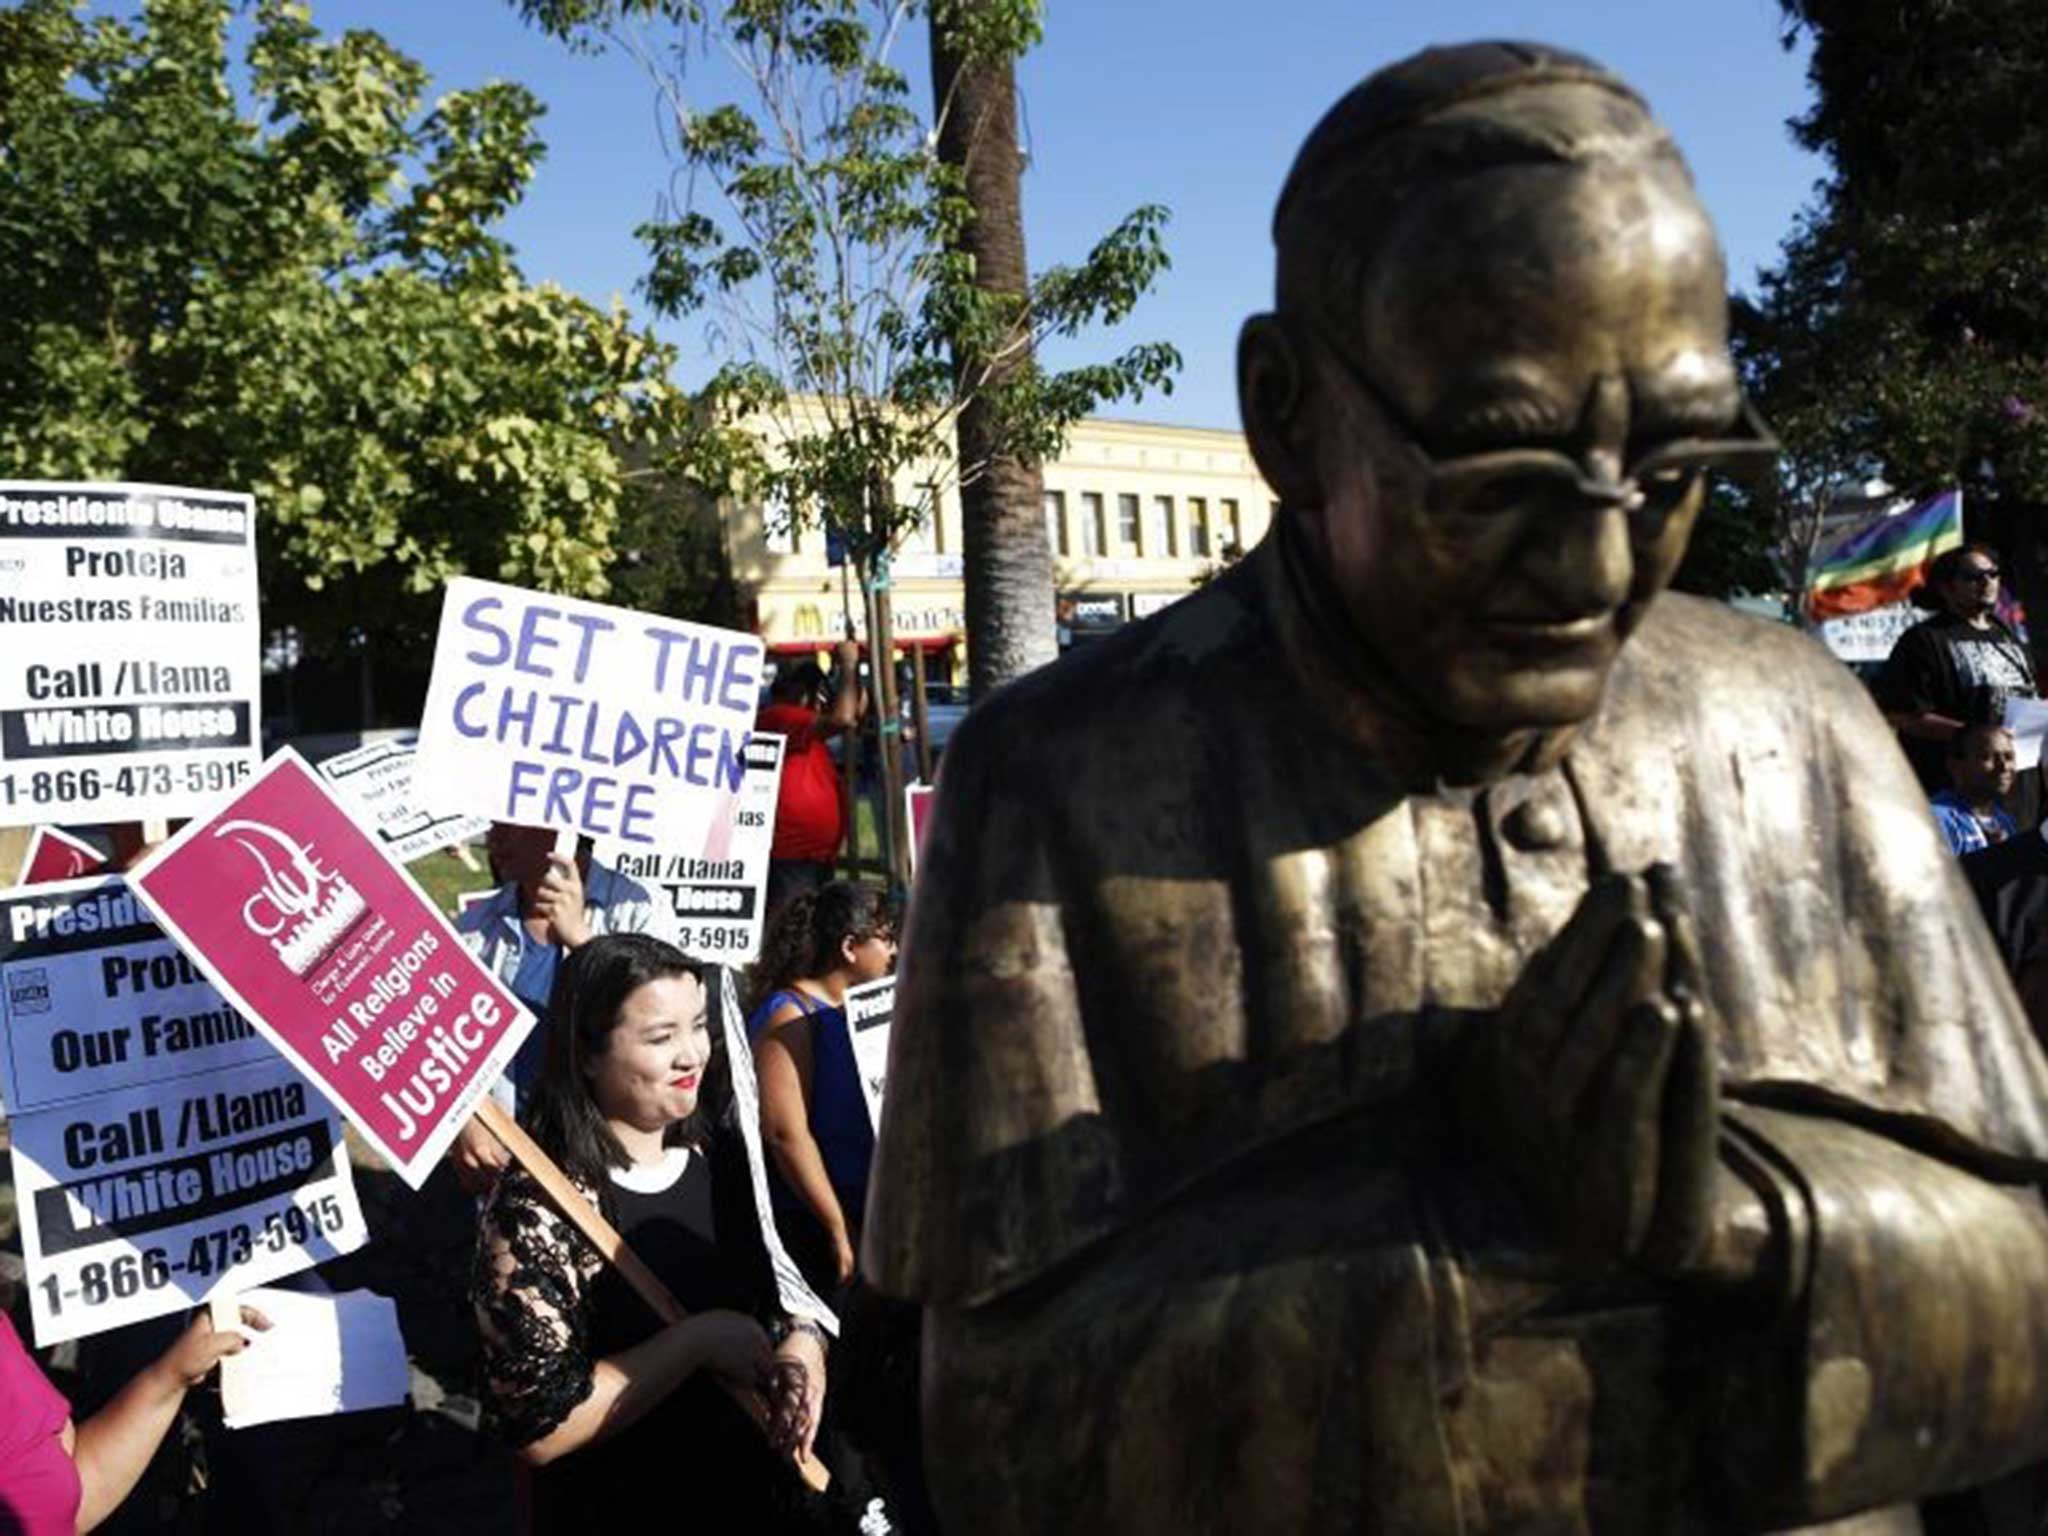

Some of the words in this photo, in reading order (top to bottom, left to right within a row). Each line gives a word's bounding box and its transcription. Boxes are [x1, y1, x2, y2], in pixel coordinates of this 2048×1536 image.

[66, 546, 186, 580] Proteja
[0, 597, 132, 623] Nuestras
[140, 596, 245, 624] Familias
[26, 663, 100, 700] Call
[114, 661, 231, 697] /Llama
[462, 597, 615, 684] SET
[644, 628, 759, 713] THE
[24, 711, 132, 746] White
[139, 706, 237, 740] House
[453, 681, 751, 794] CHILDREN
[1, 760, 250, 805] 1-866-473-5915
[507, 761, 655, 844] FREE
[616, 853, 661, 878] Call
[676, 885, 743, 911] House
[678, 926, 749, 950] 3-5915
[321, 1018, 359, 1064] All
[348, 930, 439, 1030] Religions
[52, 1025, 131, 1073] Our
[360, 992, 438, 1082] Believe
[380, 991, 501, 1141] Justice
[64, 1108, 164, 1170] Call
[177, 1082, 306, 1149] /Llama
[66, 1168, 202, 1232] White
[210, 1135, 314, 1197] House
[38, 1194, 345, 1316] 1-866-473-5915
